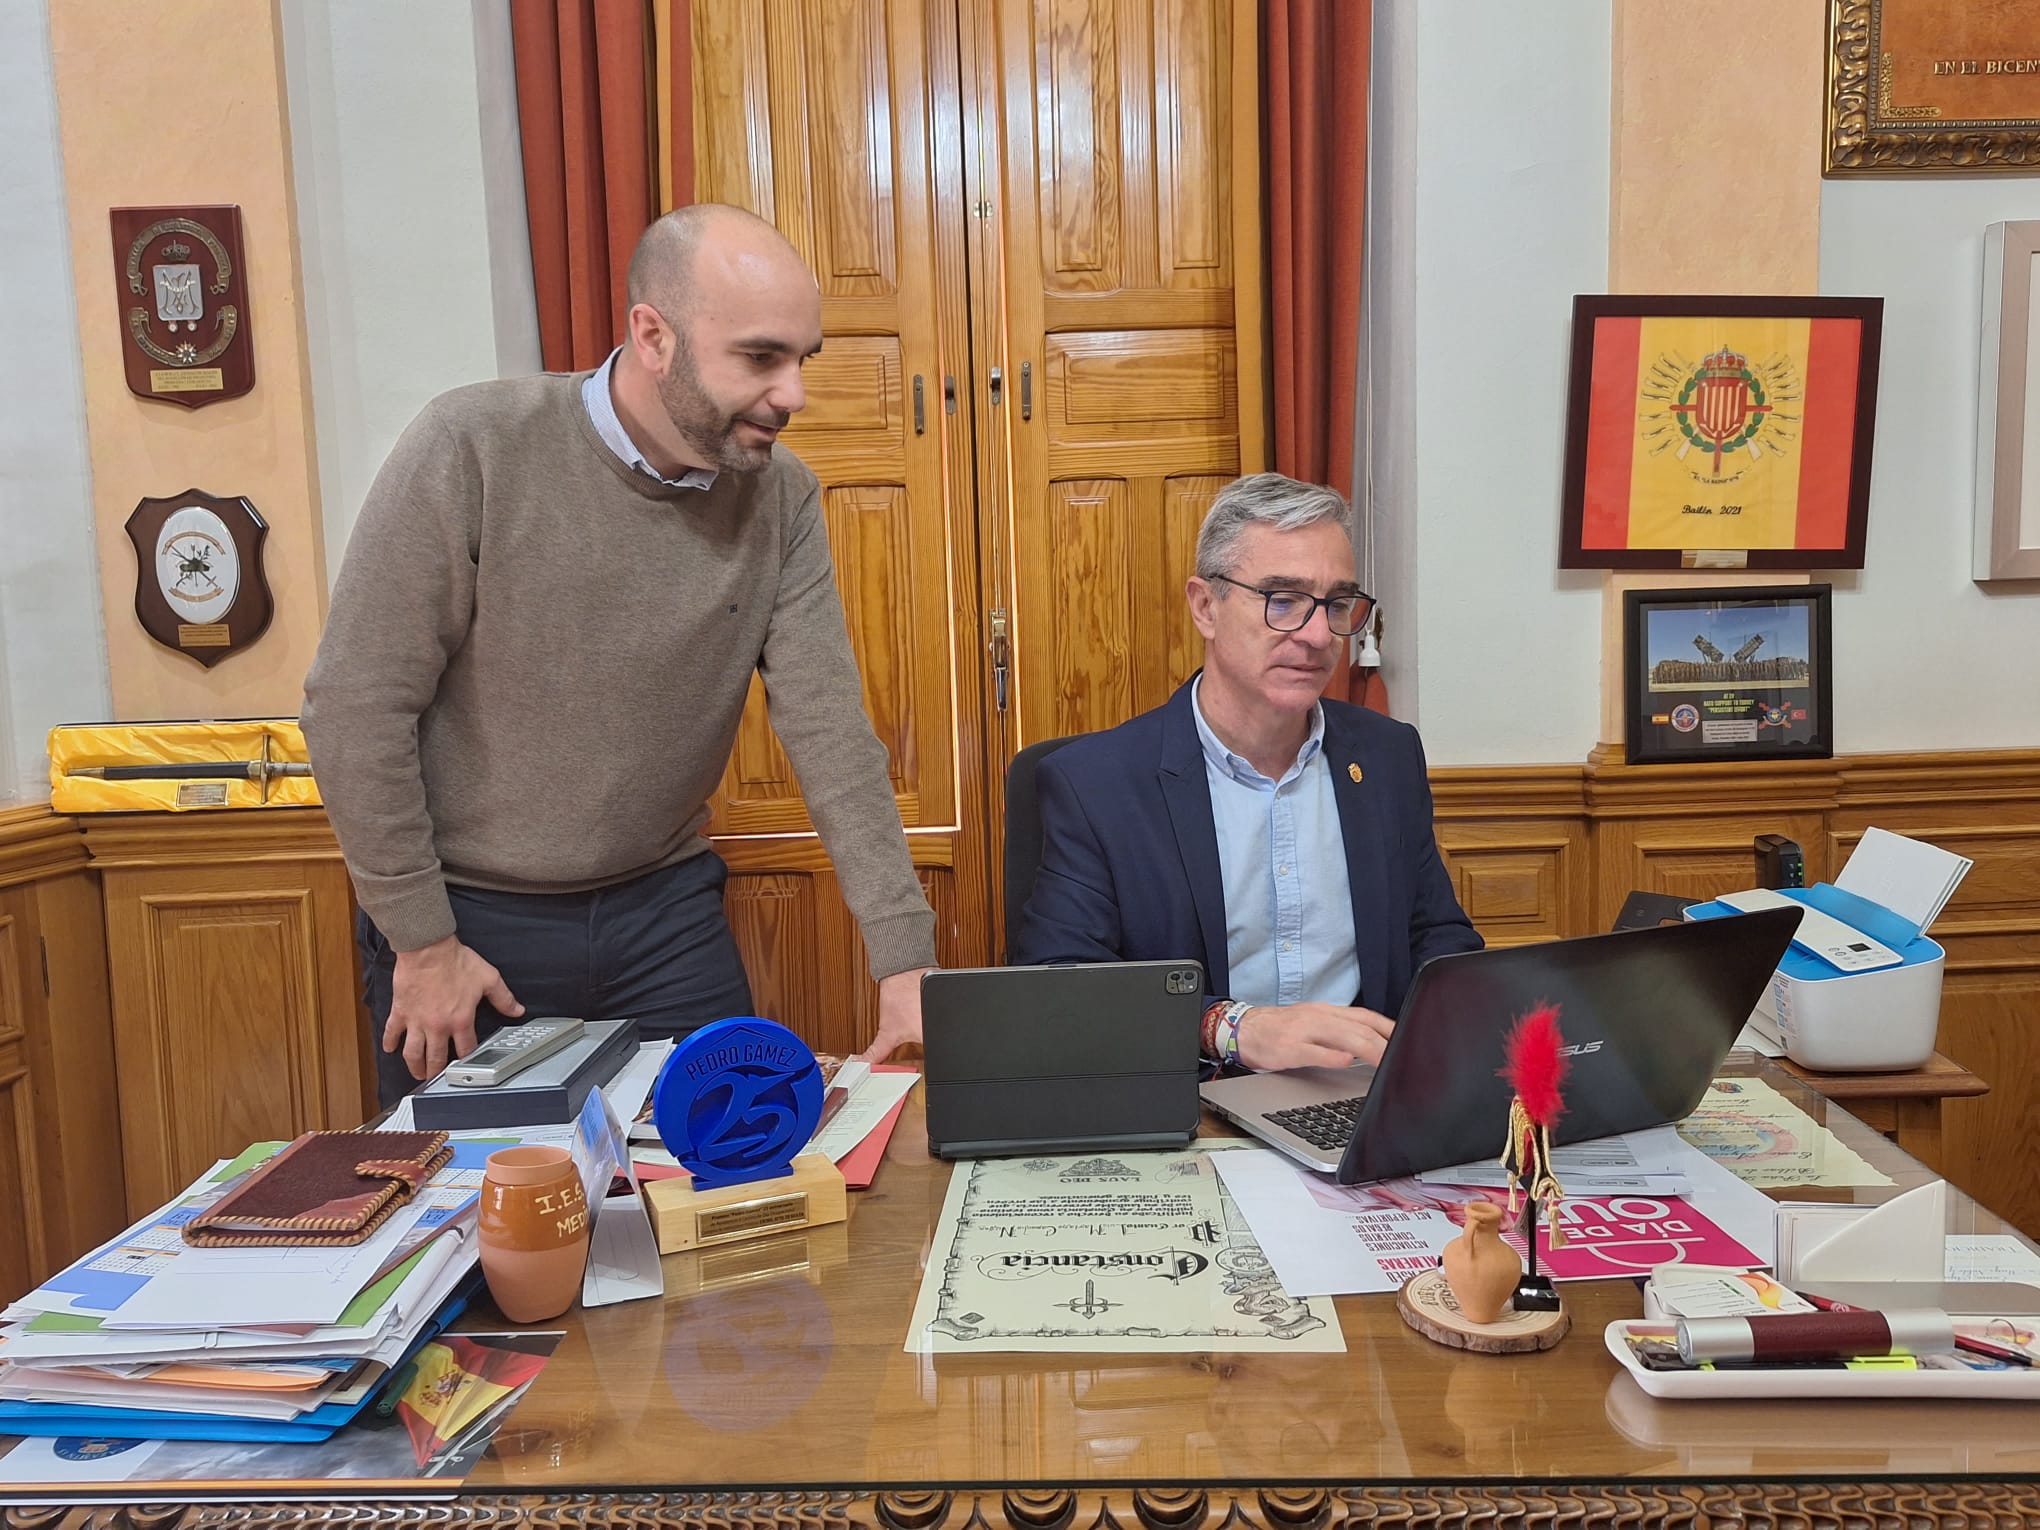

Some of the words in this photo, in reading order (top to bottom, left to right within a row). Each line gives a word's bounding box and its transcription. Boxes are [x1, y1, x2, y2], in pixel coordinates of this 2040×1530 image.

[1985, 58, 2040, 74] BICEN
[1556, 1040, 1604, 1057] SUS
[685, 1046, 739, 1081] PEDRO
[743, 1040, 798, 1068] GÁMEZ
[690, 1070, 798, 1162] 25
[1352, 1223, 1393, 1233] REGALOS
[1358, 1231, 1416, 1242] CONCIERTOS
[1365, 1240, 1429, 1252] ACTUACIONES
[1001, 1246, 1209, 1285] Constancia
[1376, 1255, 1438, 1271] ALMERAS
[1386, 1271, 1421, 1284] ASEO
